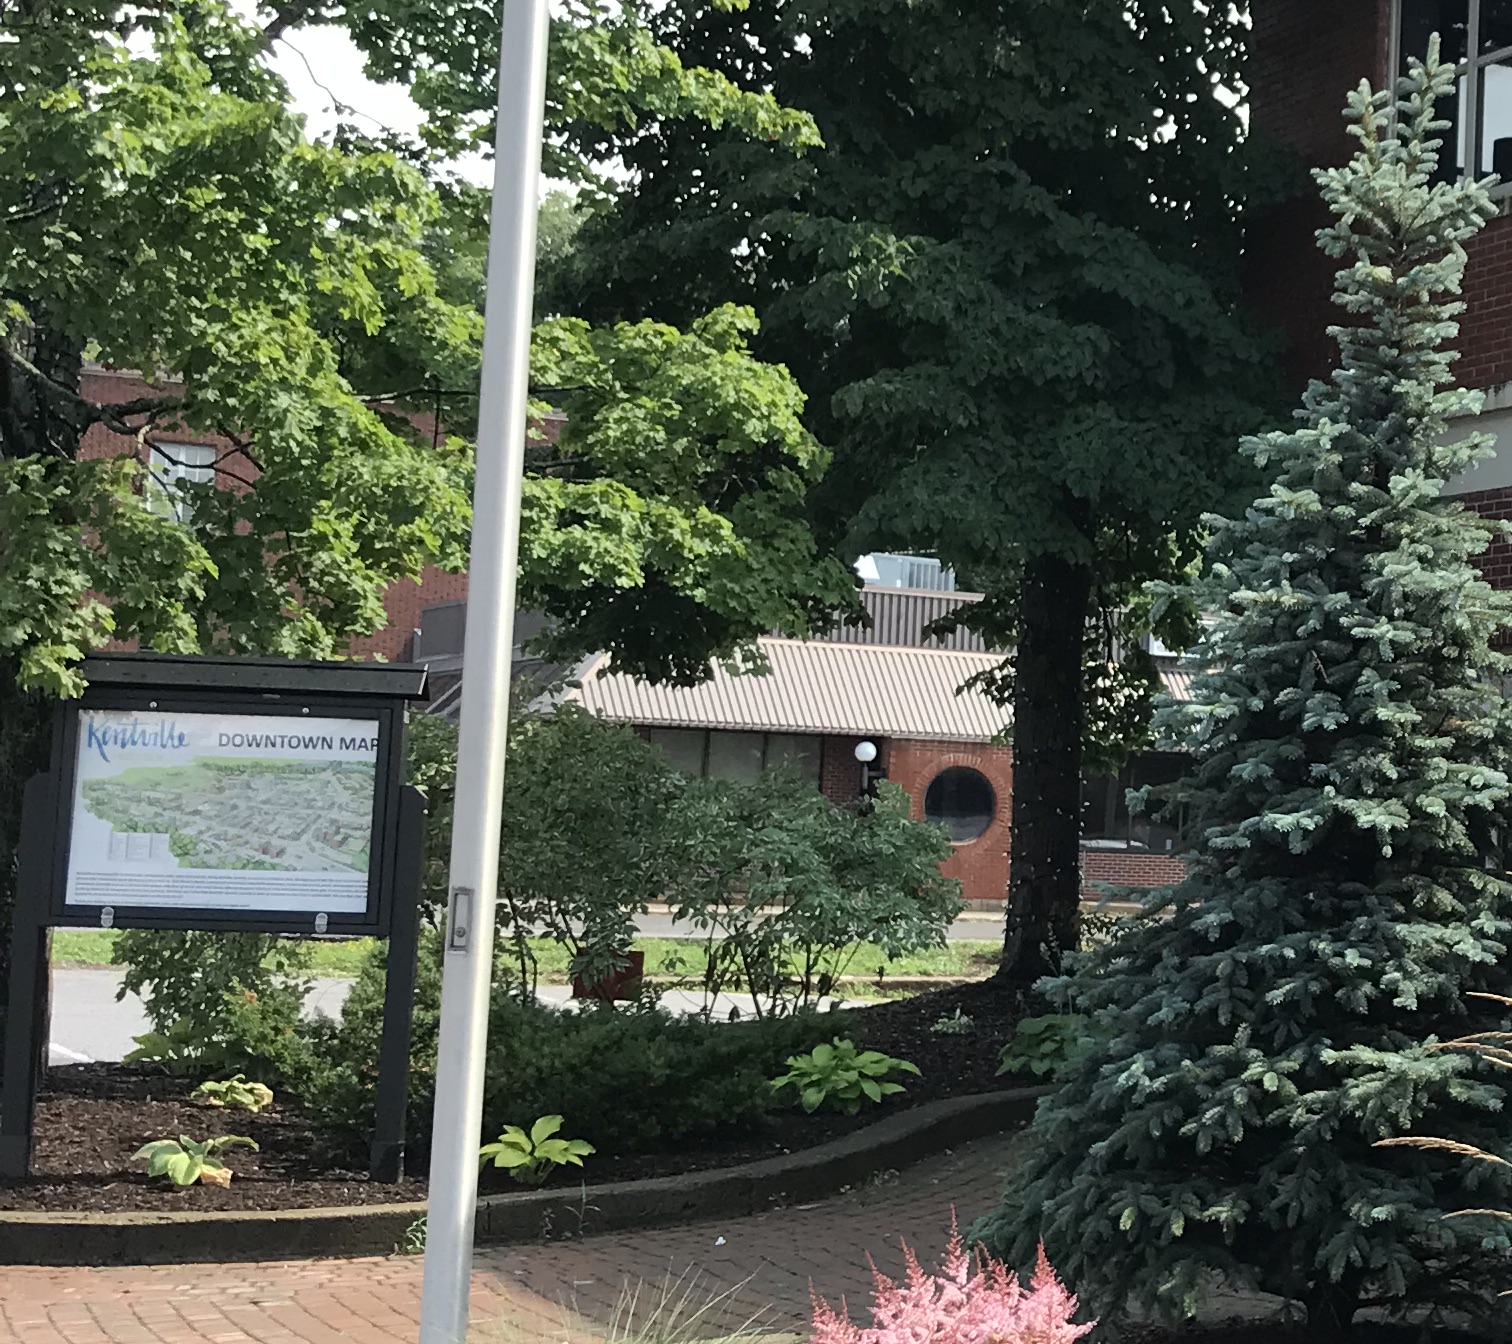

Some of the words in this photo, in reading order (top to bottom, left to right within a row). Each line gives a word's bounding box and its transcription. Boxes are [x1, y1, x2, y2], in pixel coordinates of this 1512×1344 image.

[86, 719, 190, 763] Kentville
[218, 732, 333, 750] DOWNTOWN
[339, 736, 379, 752] MAP
